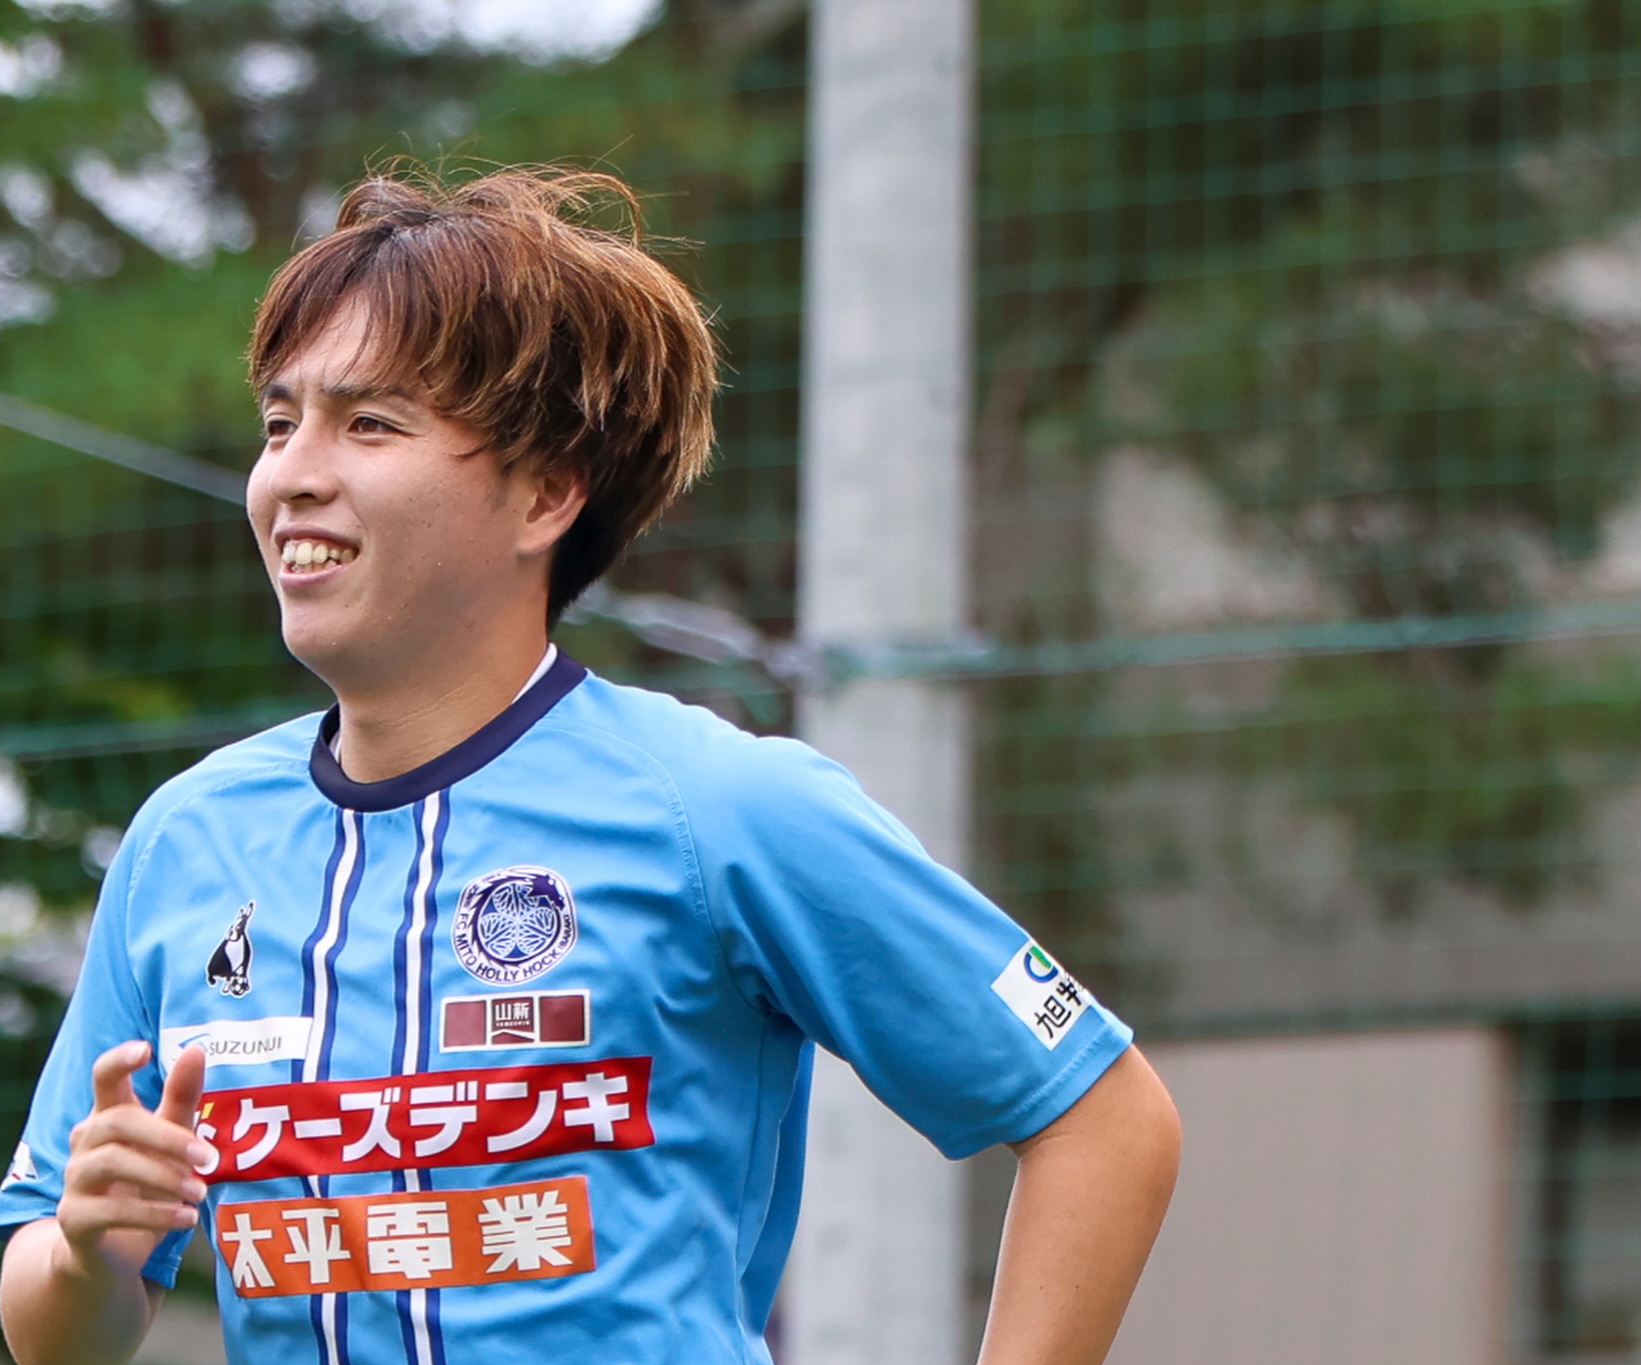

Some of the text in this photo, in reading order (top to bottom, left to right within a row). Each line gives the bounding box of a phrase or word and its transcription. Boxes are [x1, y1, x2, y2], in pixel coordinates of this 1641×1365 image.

[456, 913, 560, 981] FC MITO HOLLY HOCK
[494, 1002, 530, 1021] 山新
[231, 1072, 630, 1171] ケーズデンキ
[221, 1190, 574, 1289] 太平電業
